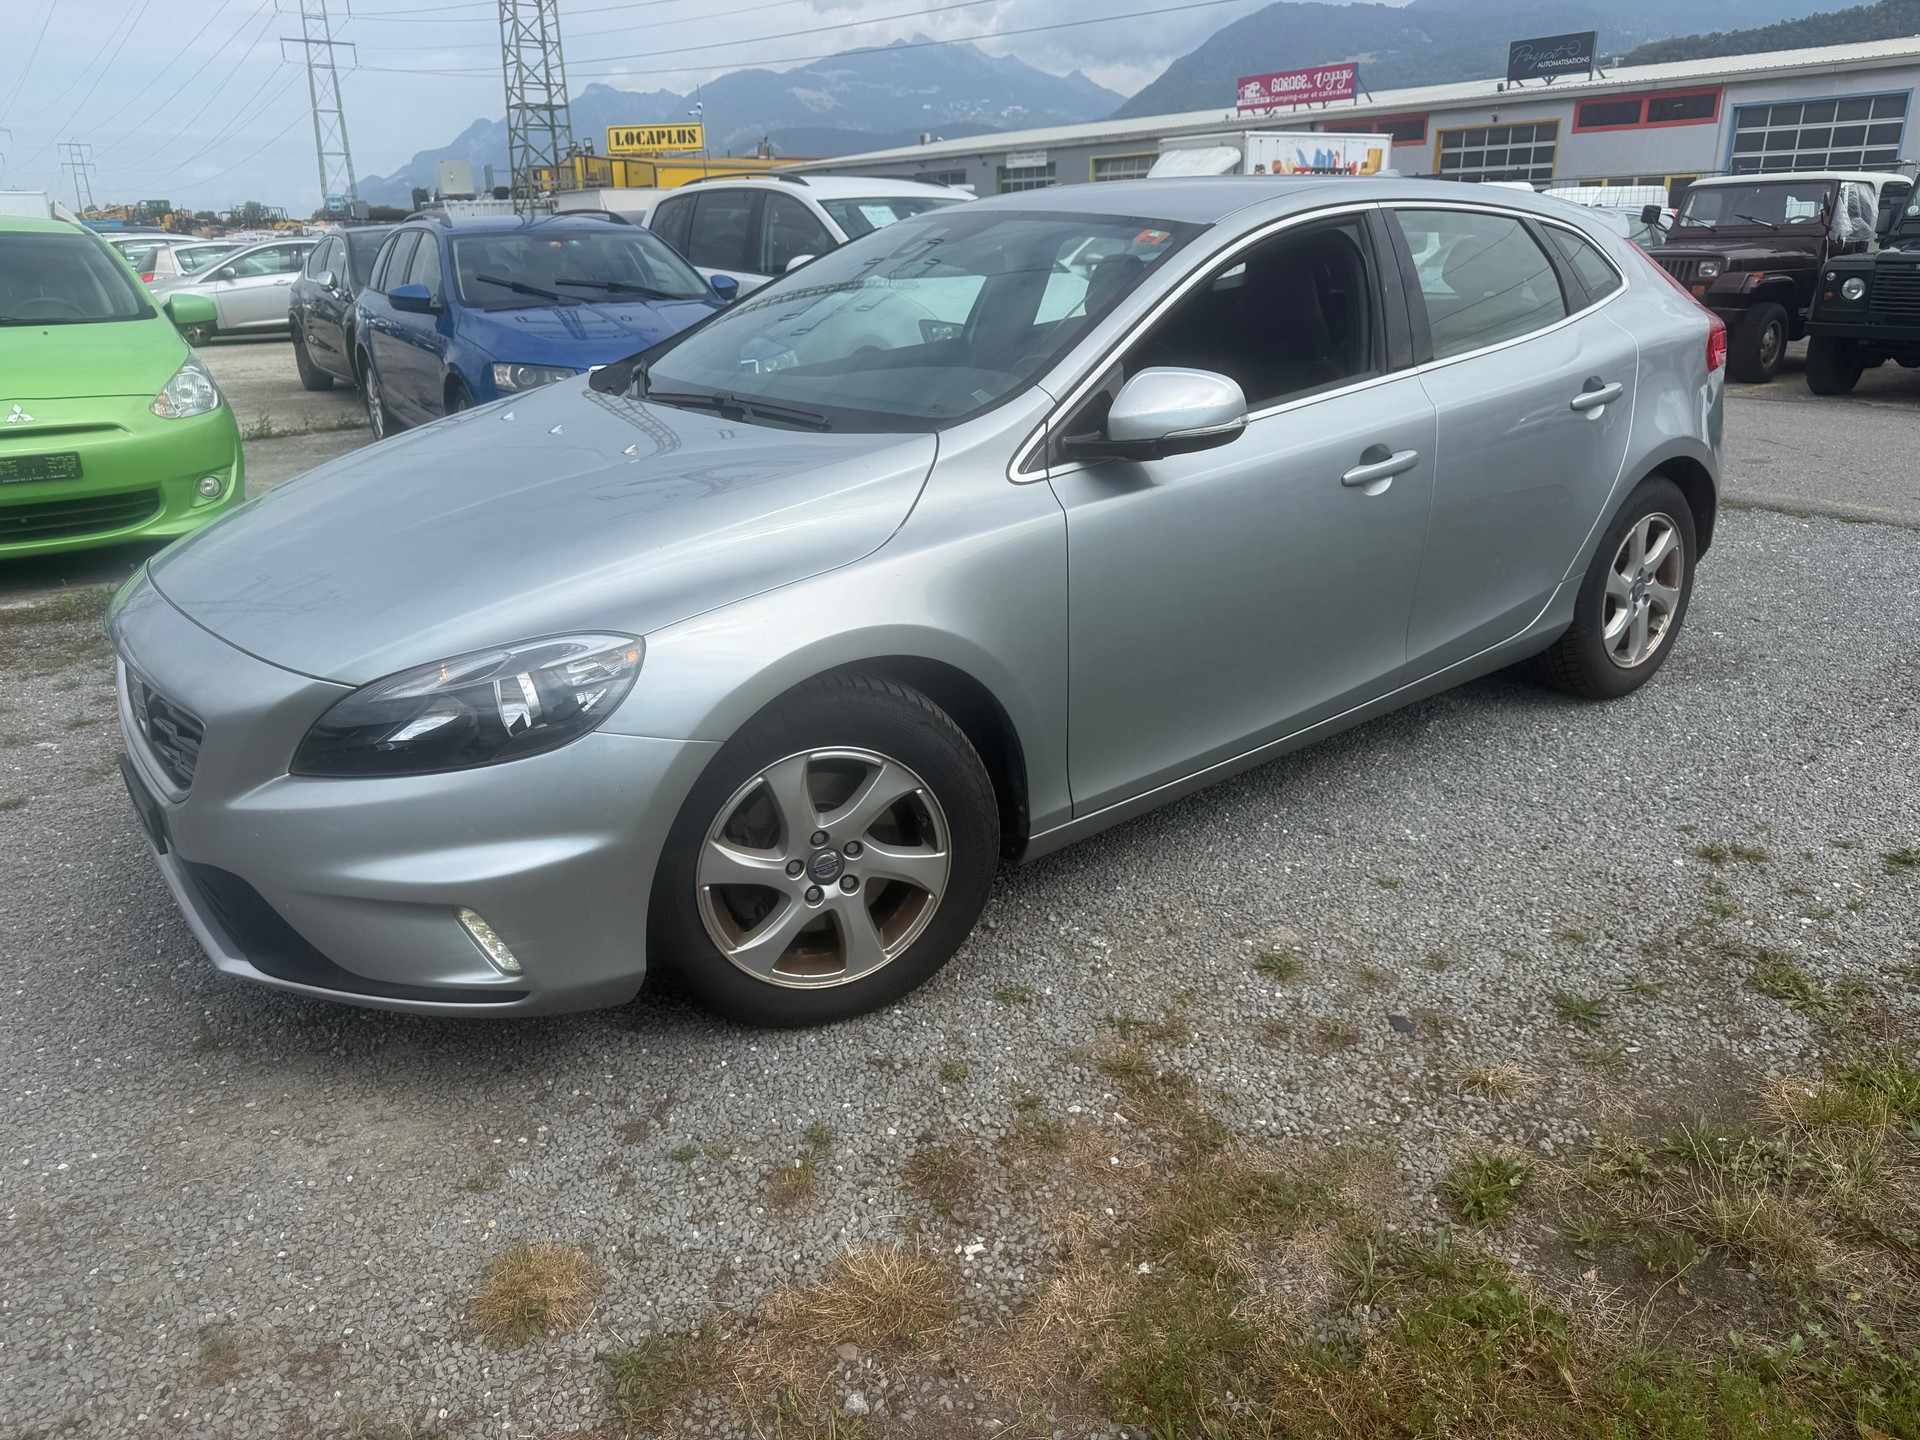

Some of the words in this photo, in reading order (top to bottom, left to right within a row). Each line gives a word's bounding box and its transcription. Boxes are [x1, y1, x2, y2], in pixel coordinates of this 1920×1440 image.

[1537, 56, 1590, 68] AUTOMATISATIONS
[1271, 92, 1310, 102] Camping-car
[1319, 88, 1353, 97] caravanes
[615, 129, 697, 146] LOCAPLUS
